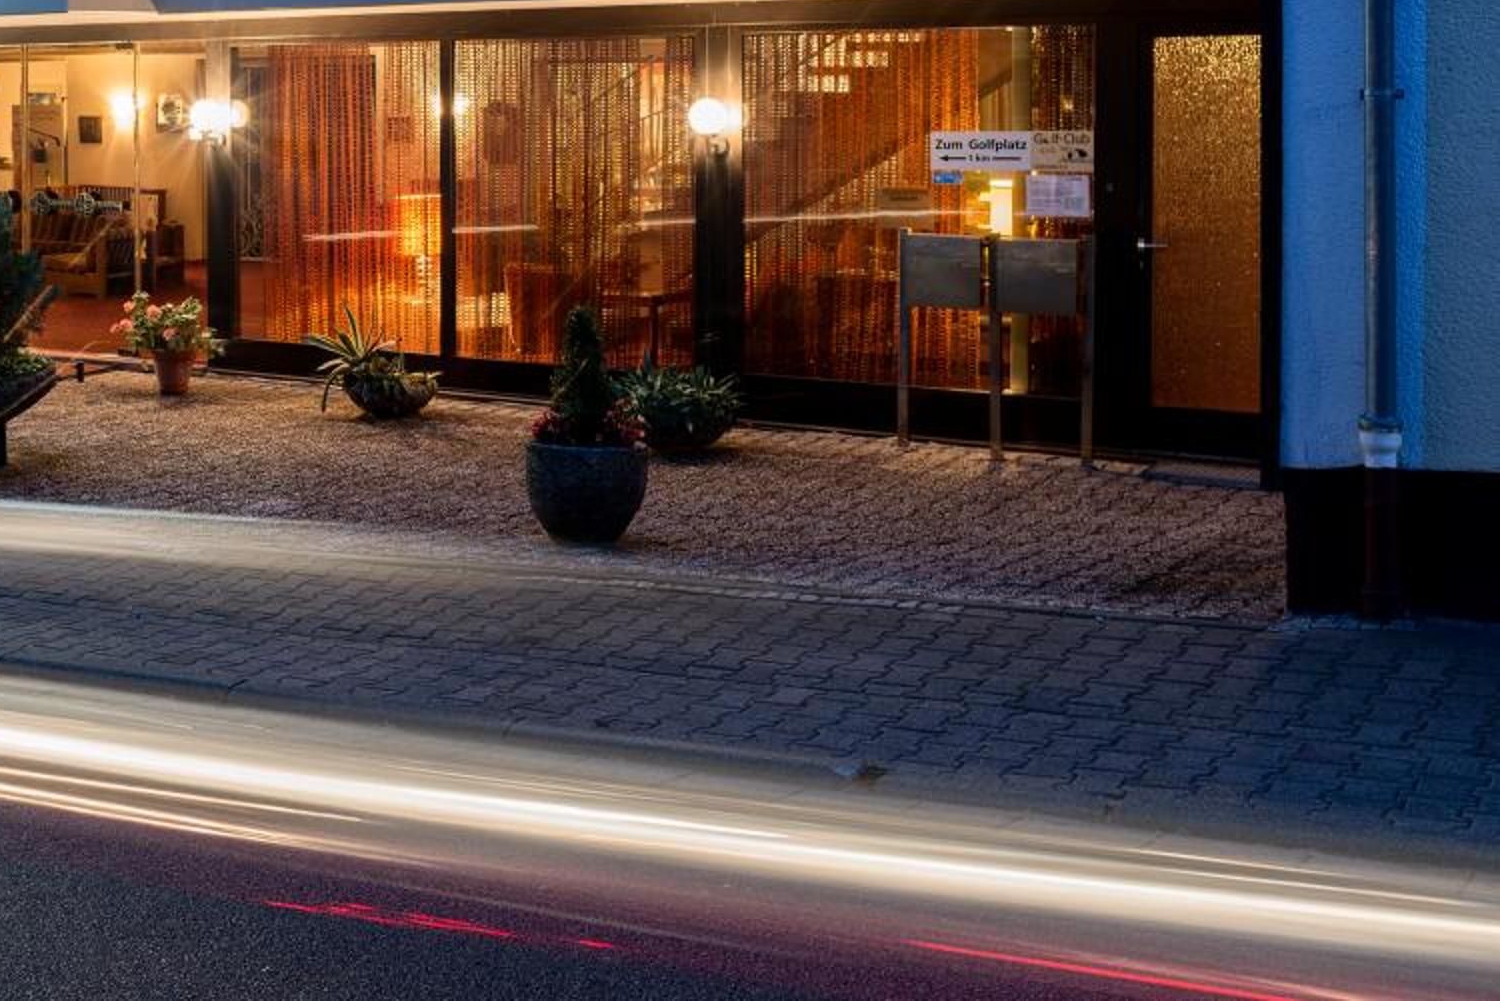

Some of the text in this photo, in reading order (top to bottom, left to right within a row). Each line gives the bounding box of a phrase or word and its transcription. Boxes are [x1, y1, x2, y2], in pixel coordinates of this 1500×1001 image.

[935, 137, 963, 150] Zum
[969, 137, 1028, 151] Golfplatz
[975, 154, 990, 162] km
